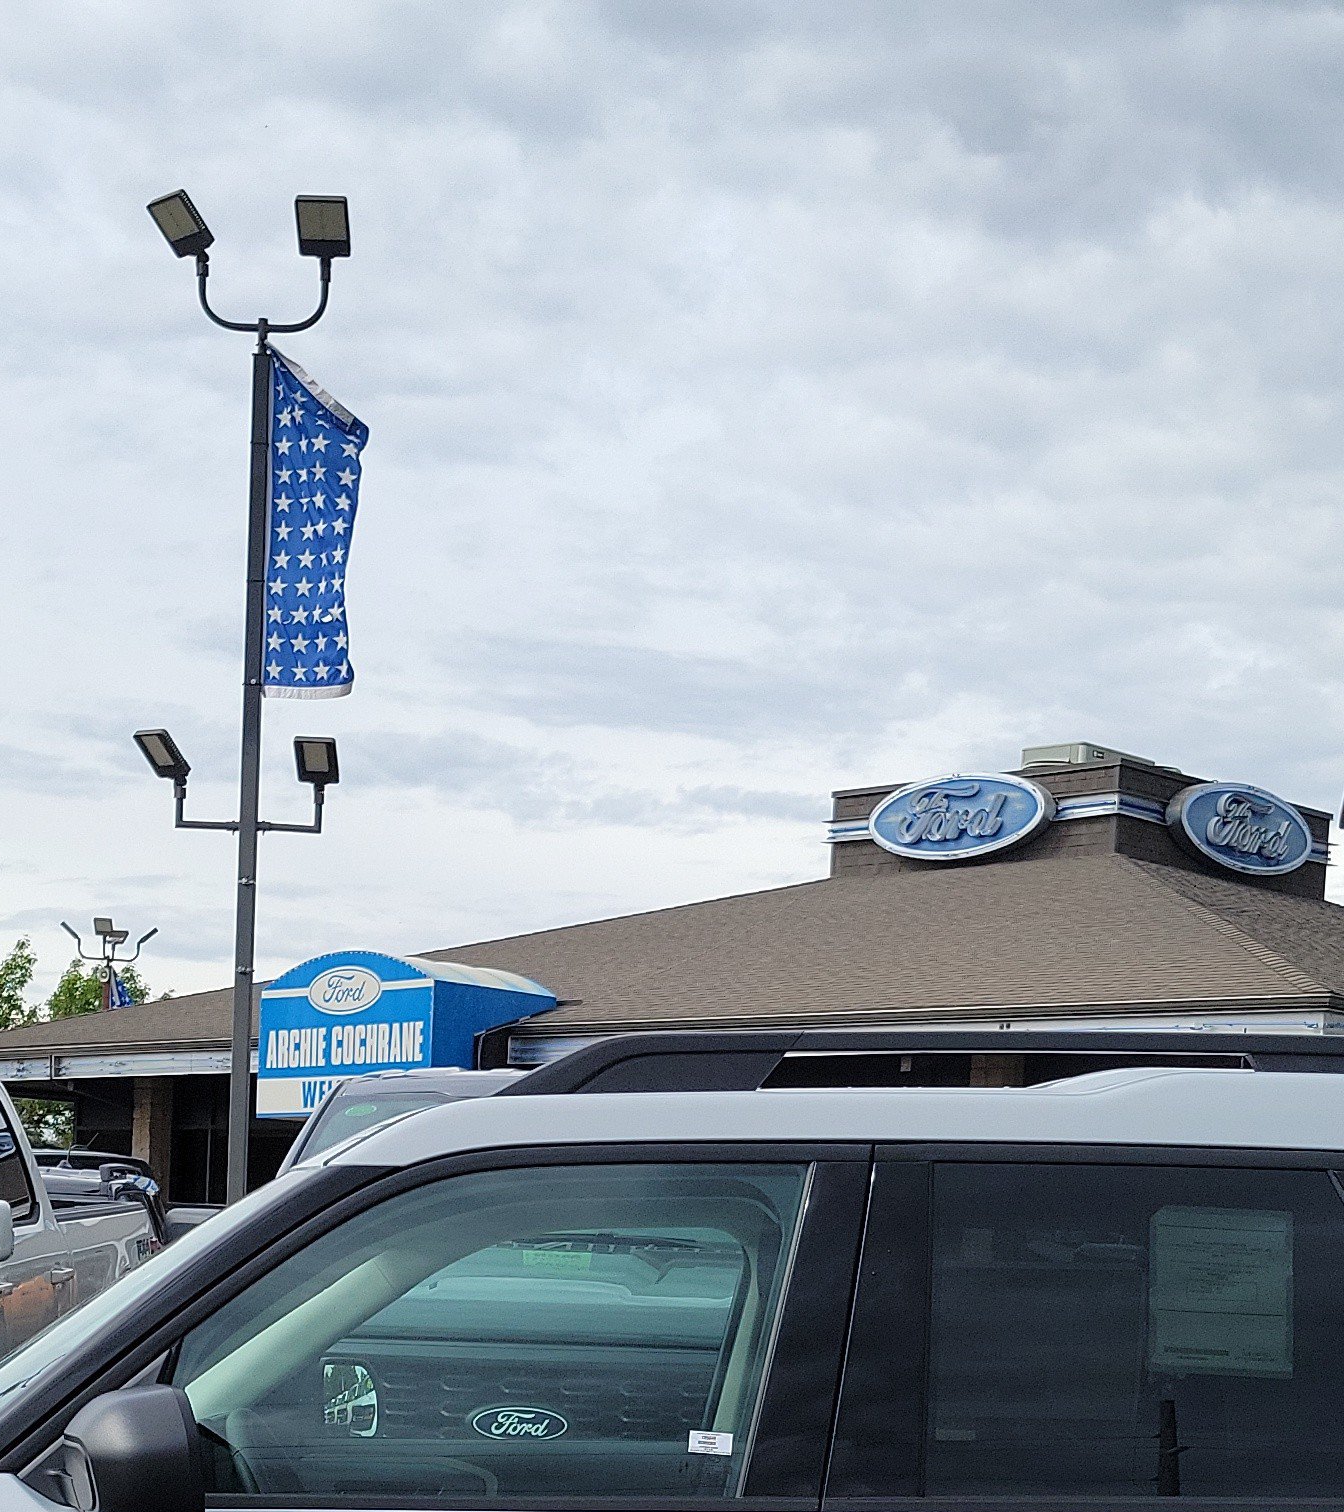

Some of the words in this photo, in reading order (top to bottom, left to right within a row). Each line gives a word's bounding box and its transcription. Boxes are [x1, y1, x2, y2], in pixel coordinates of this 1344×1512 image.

[896, 783, 1007, 844] Ford
[1207, 792, 1292, 861] Ford
[323, 974, 365, 1003] Ford
[265, 1027, 327, 1069] ARCHIE
[331, 1020, 424, 1066] COCHRANE
[491, 1411, 550, 1437] Ford
